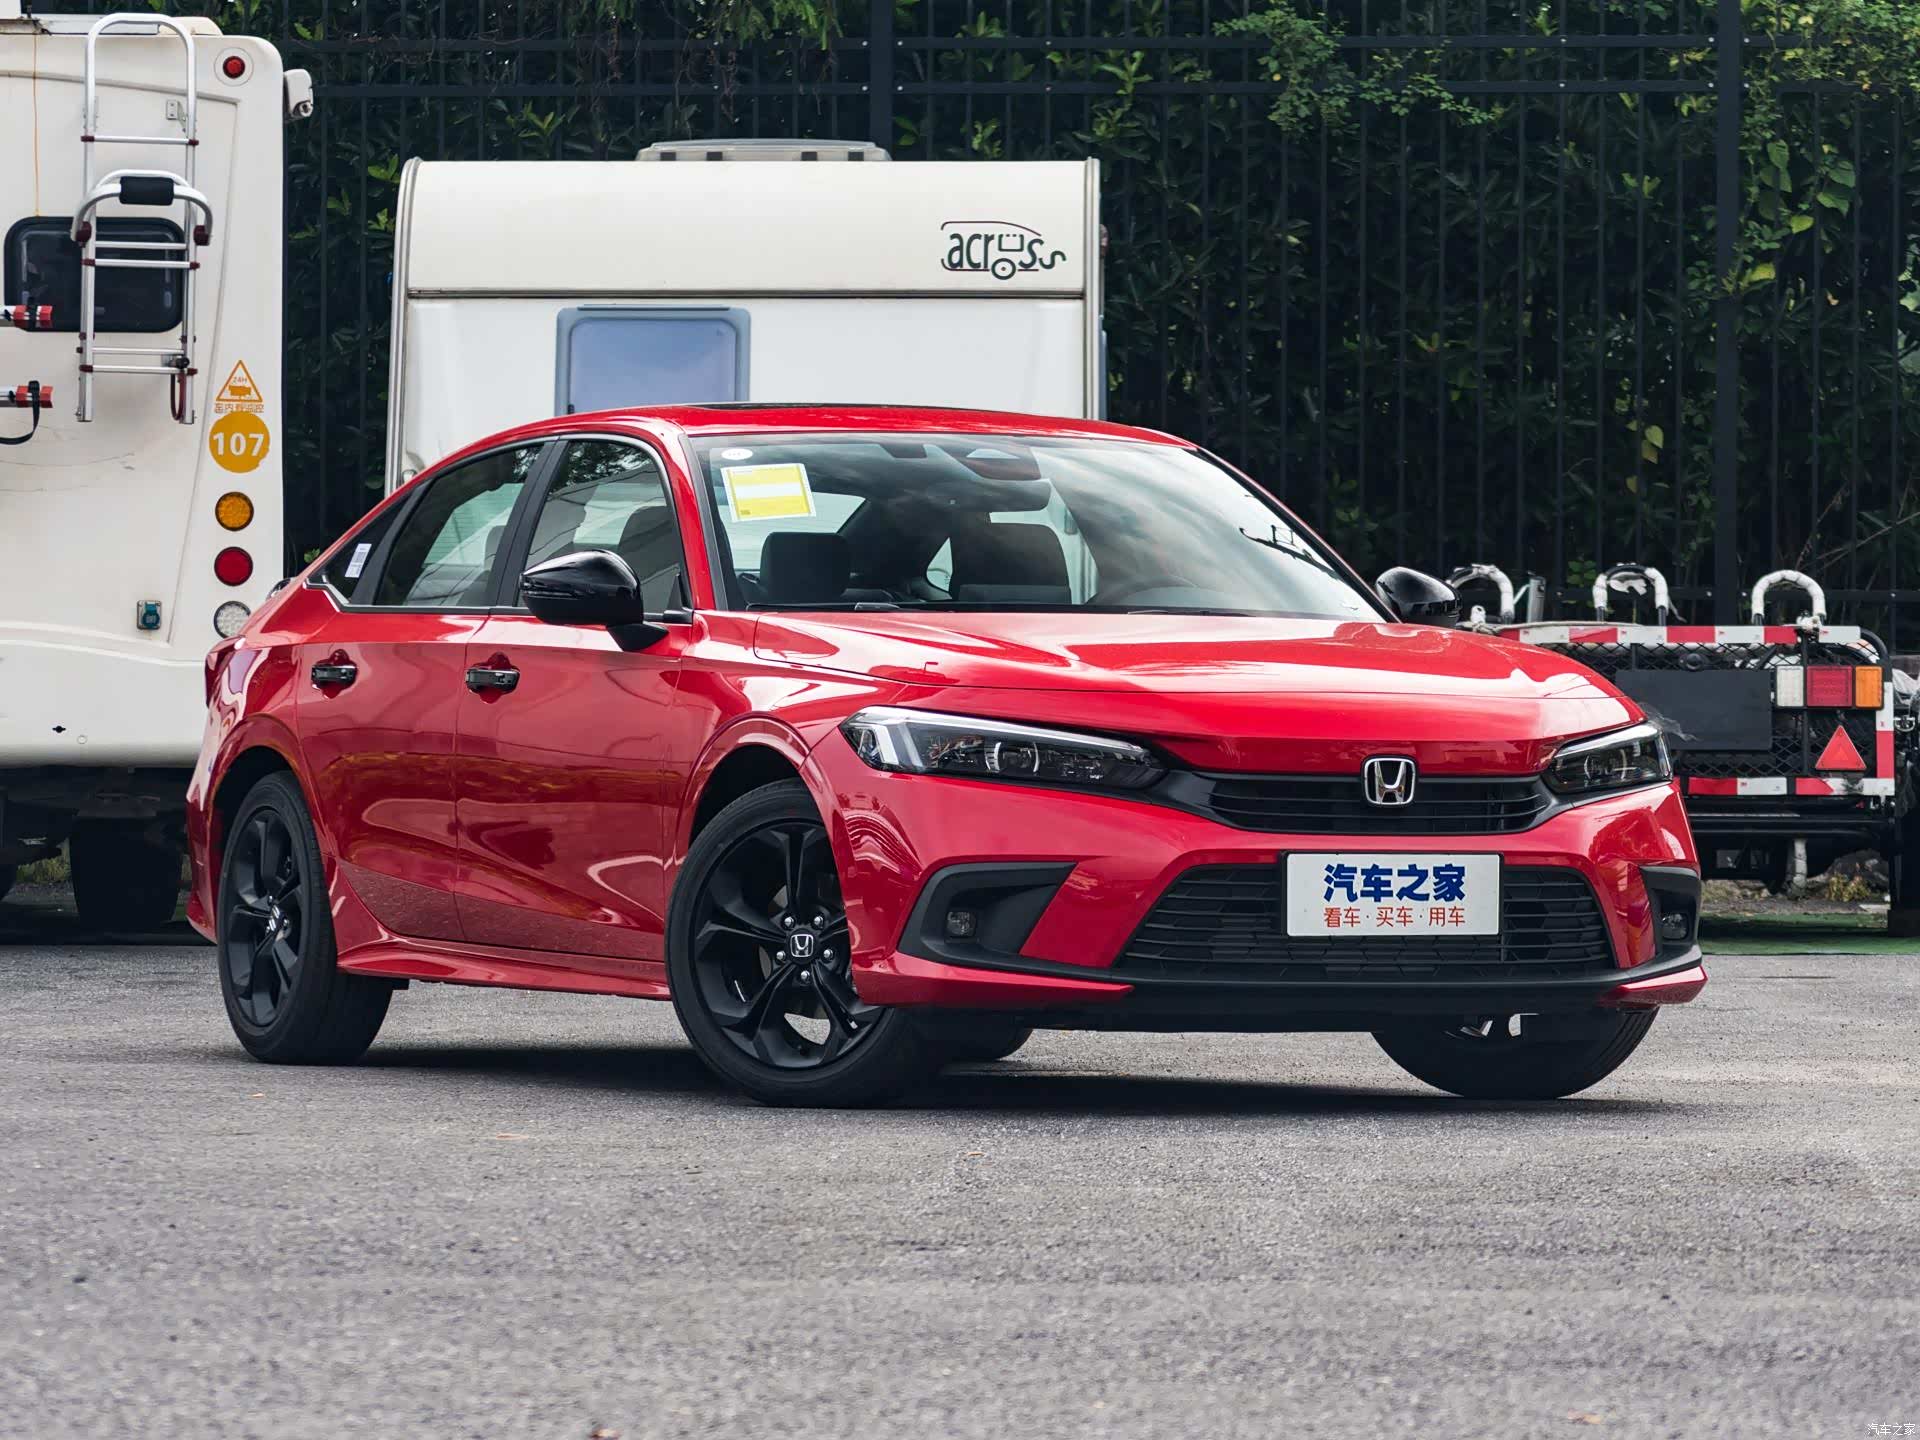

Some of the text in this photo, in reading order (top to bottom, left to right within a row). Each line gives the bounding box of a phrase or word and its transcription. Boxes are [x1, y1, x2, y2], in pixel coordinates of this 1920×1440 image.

[213, 432, 265, 457] 107
[1323, 863, 1466, 903] 汽车之家
